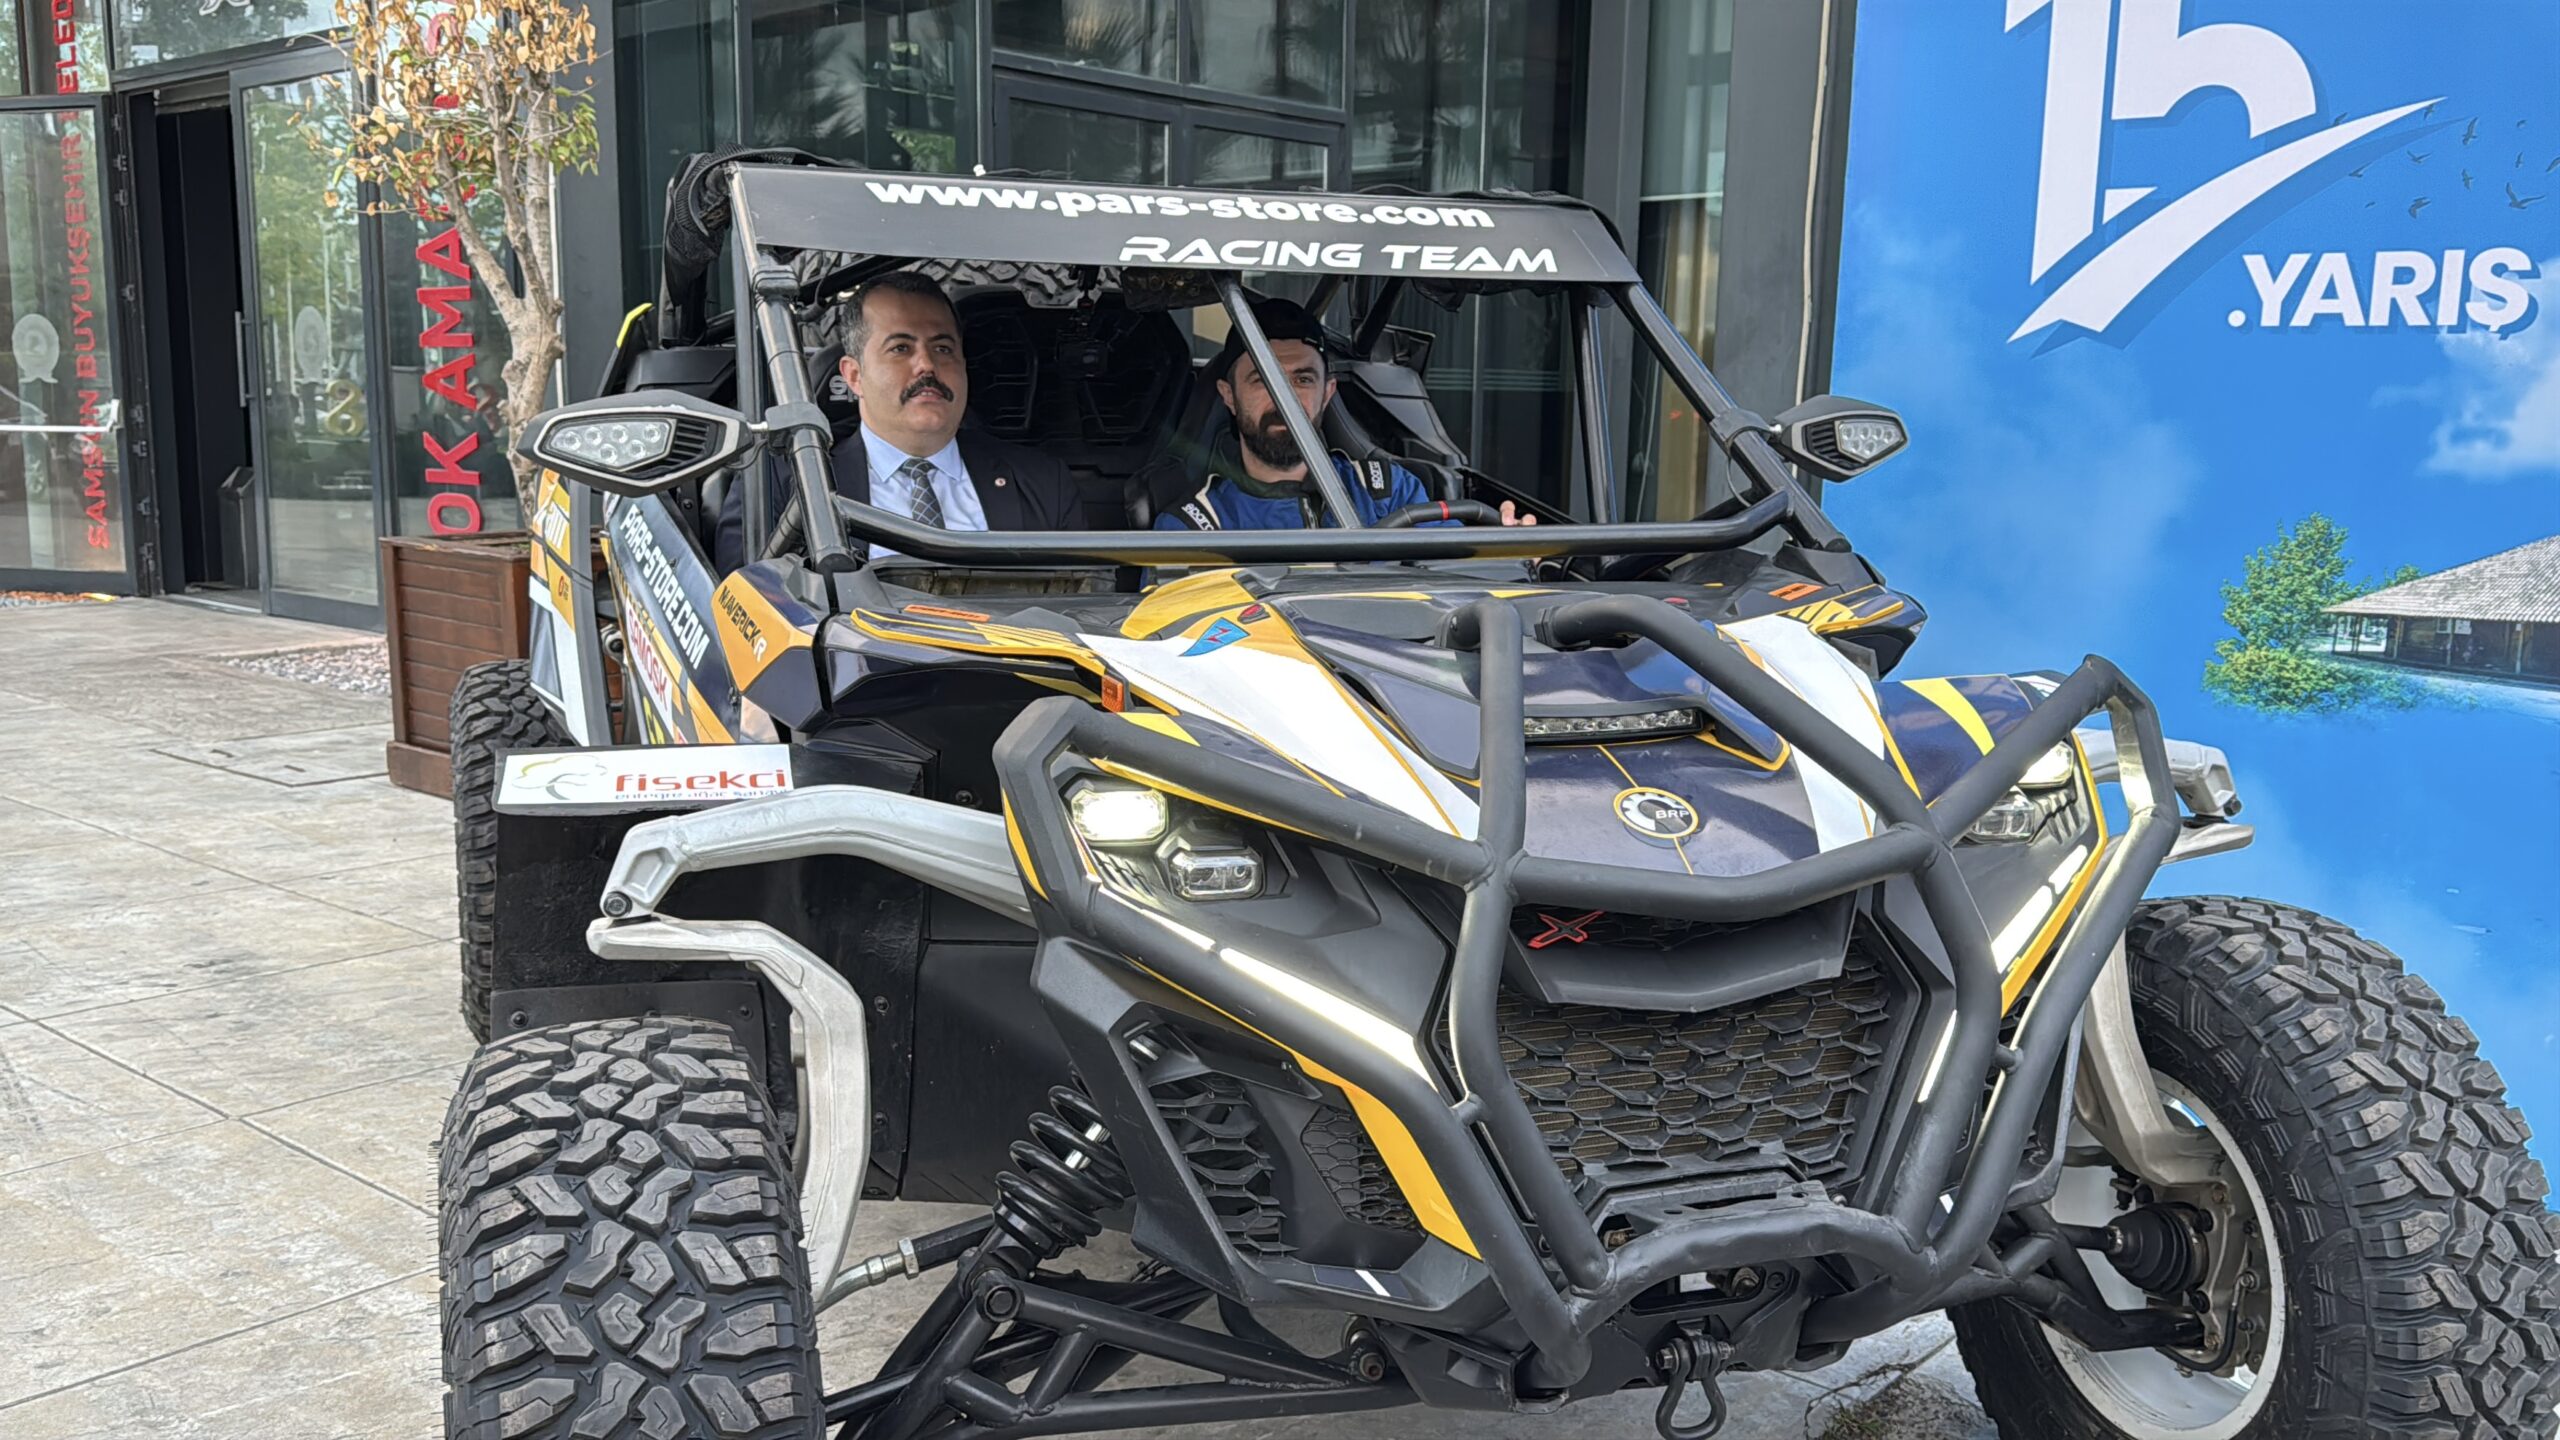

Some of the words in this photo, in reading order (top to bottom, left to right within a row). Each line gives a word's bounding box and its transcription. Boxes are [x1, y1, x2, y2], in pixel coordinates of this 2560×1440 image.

[865, 182, 1495, 228] www.pars-store.com
[1118, 236, 1363, 268] RACING
[1381, 244, 1558, 273] TEAM
[620, 503, 711, 670] PARS-STORE.COM
[615, 769, 786, 792] fisekci
[1655, 809, 1690, 819] BRP
